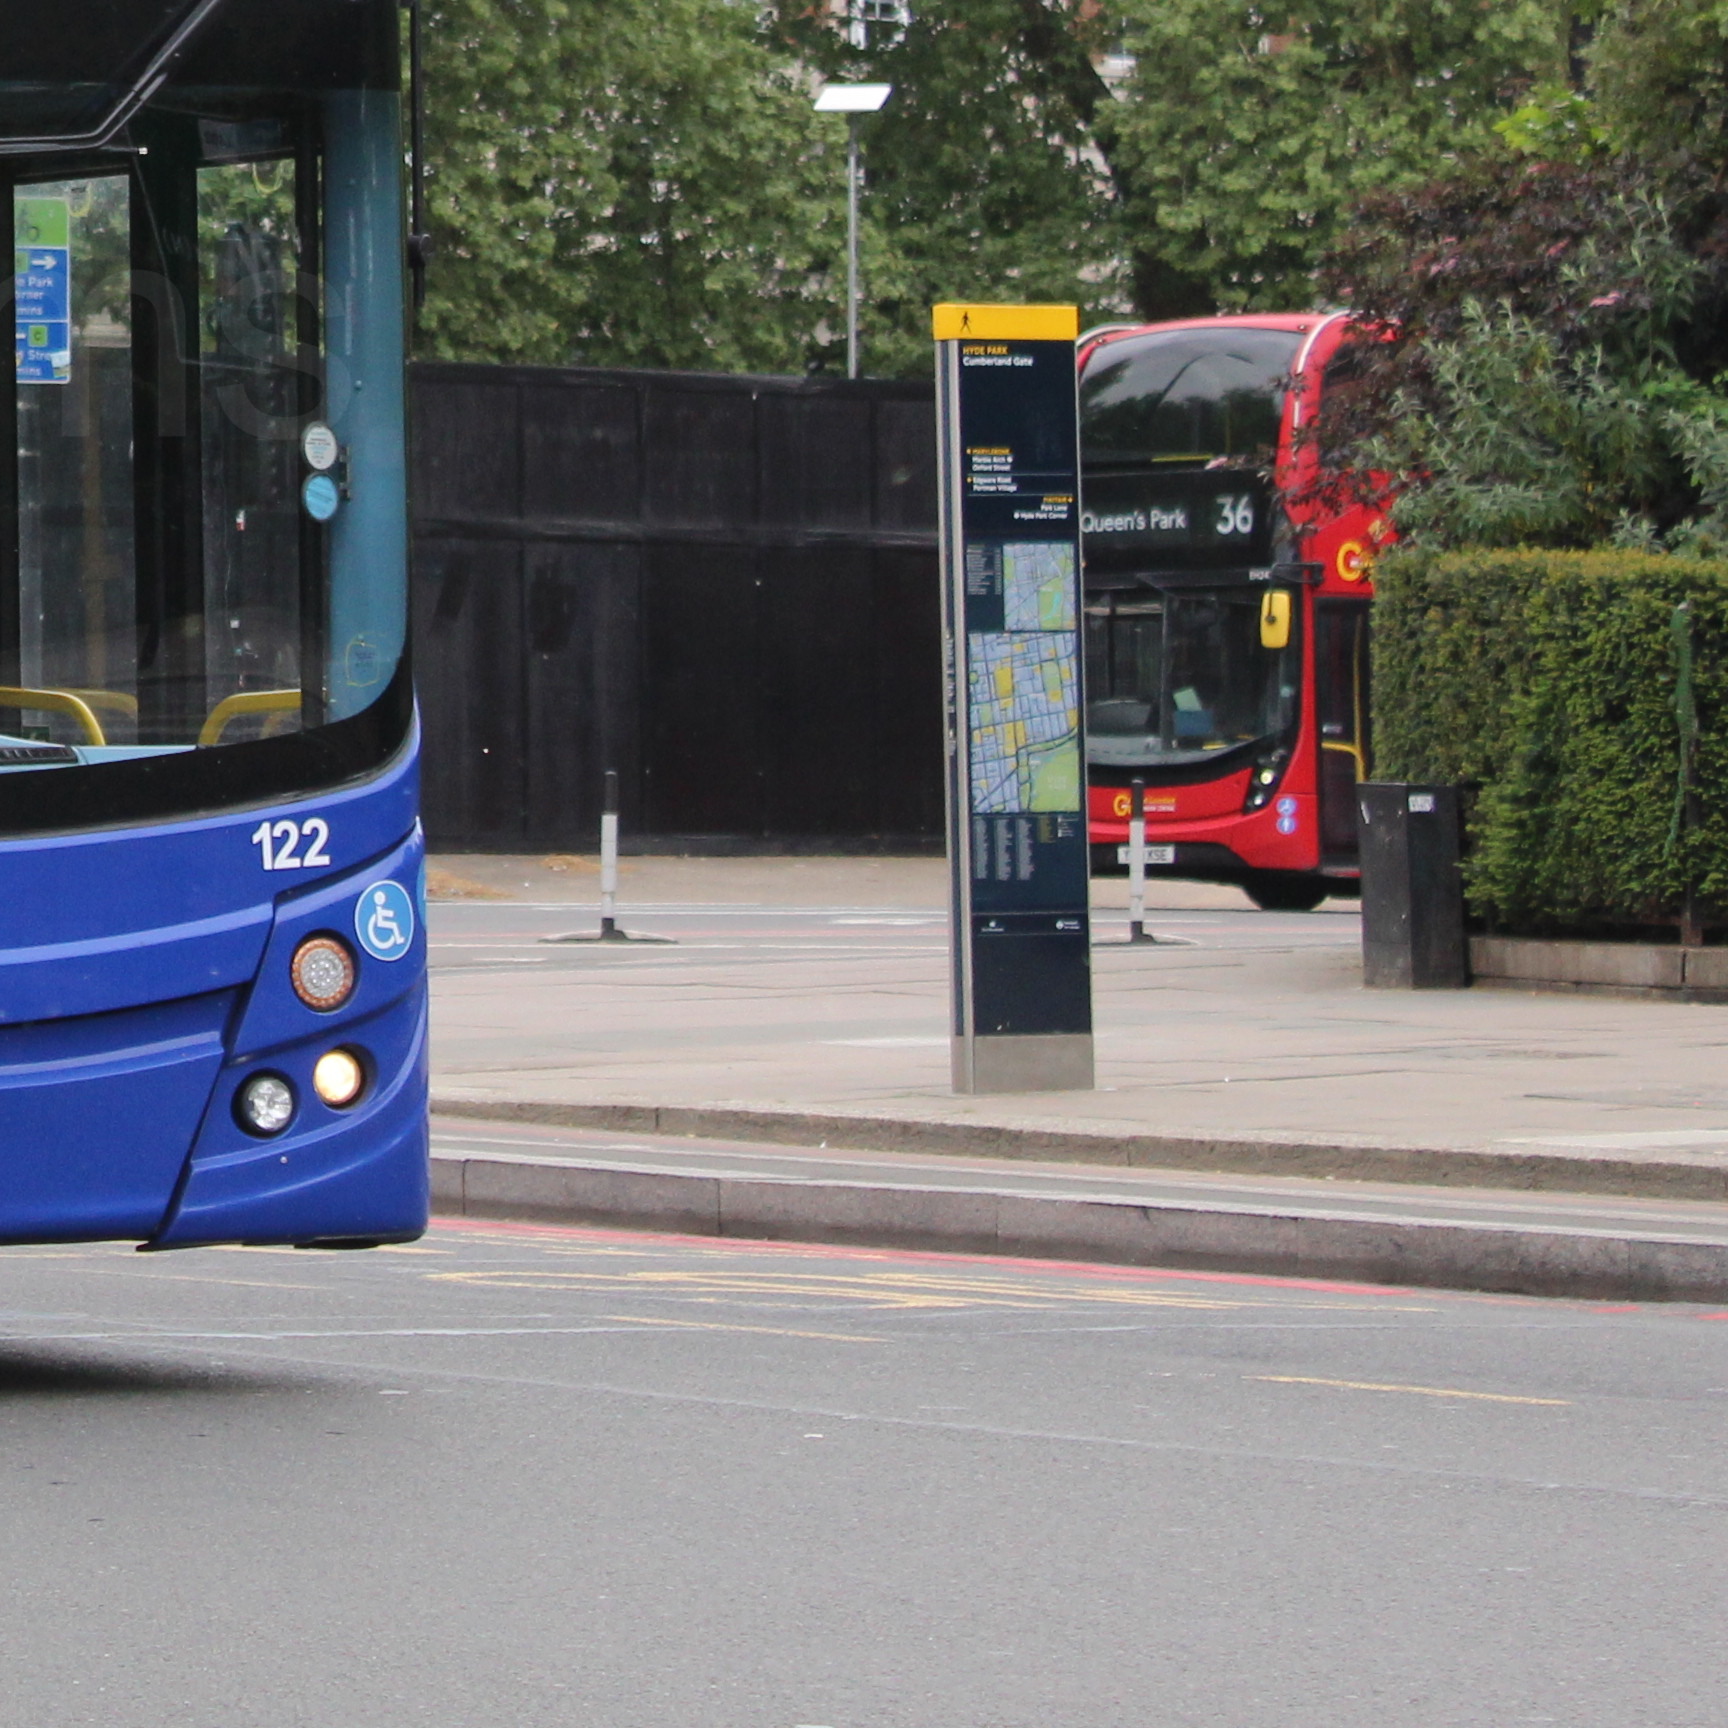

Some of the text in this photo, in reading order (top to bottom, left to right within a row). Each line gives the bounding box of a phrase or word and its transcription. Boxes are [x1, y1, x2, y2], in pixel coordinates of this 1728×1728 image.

[28, 276, 53, 287] Park
[963, 345, 1008, 355] HYDE PARK
[963, 356, 1033, 366] Cumberland Gate
[1080, 495, 1253, 535] Queen's Park 36
[251, 817, 331, 871] 122
